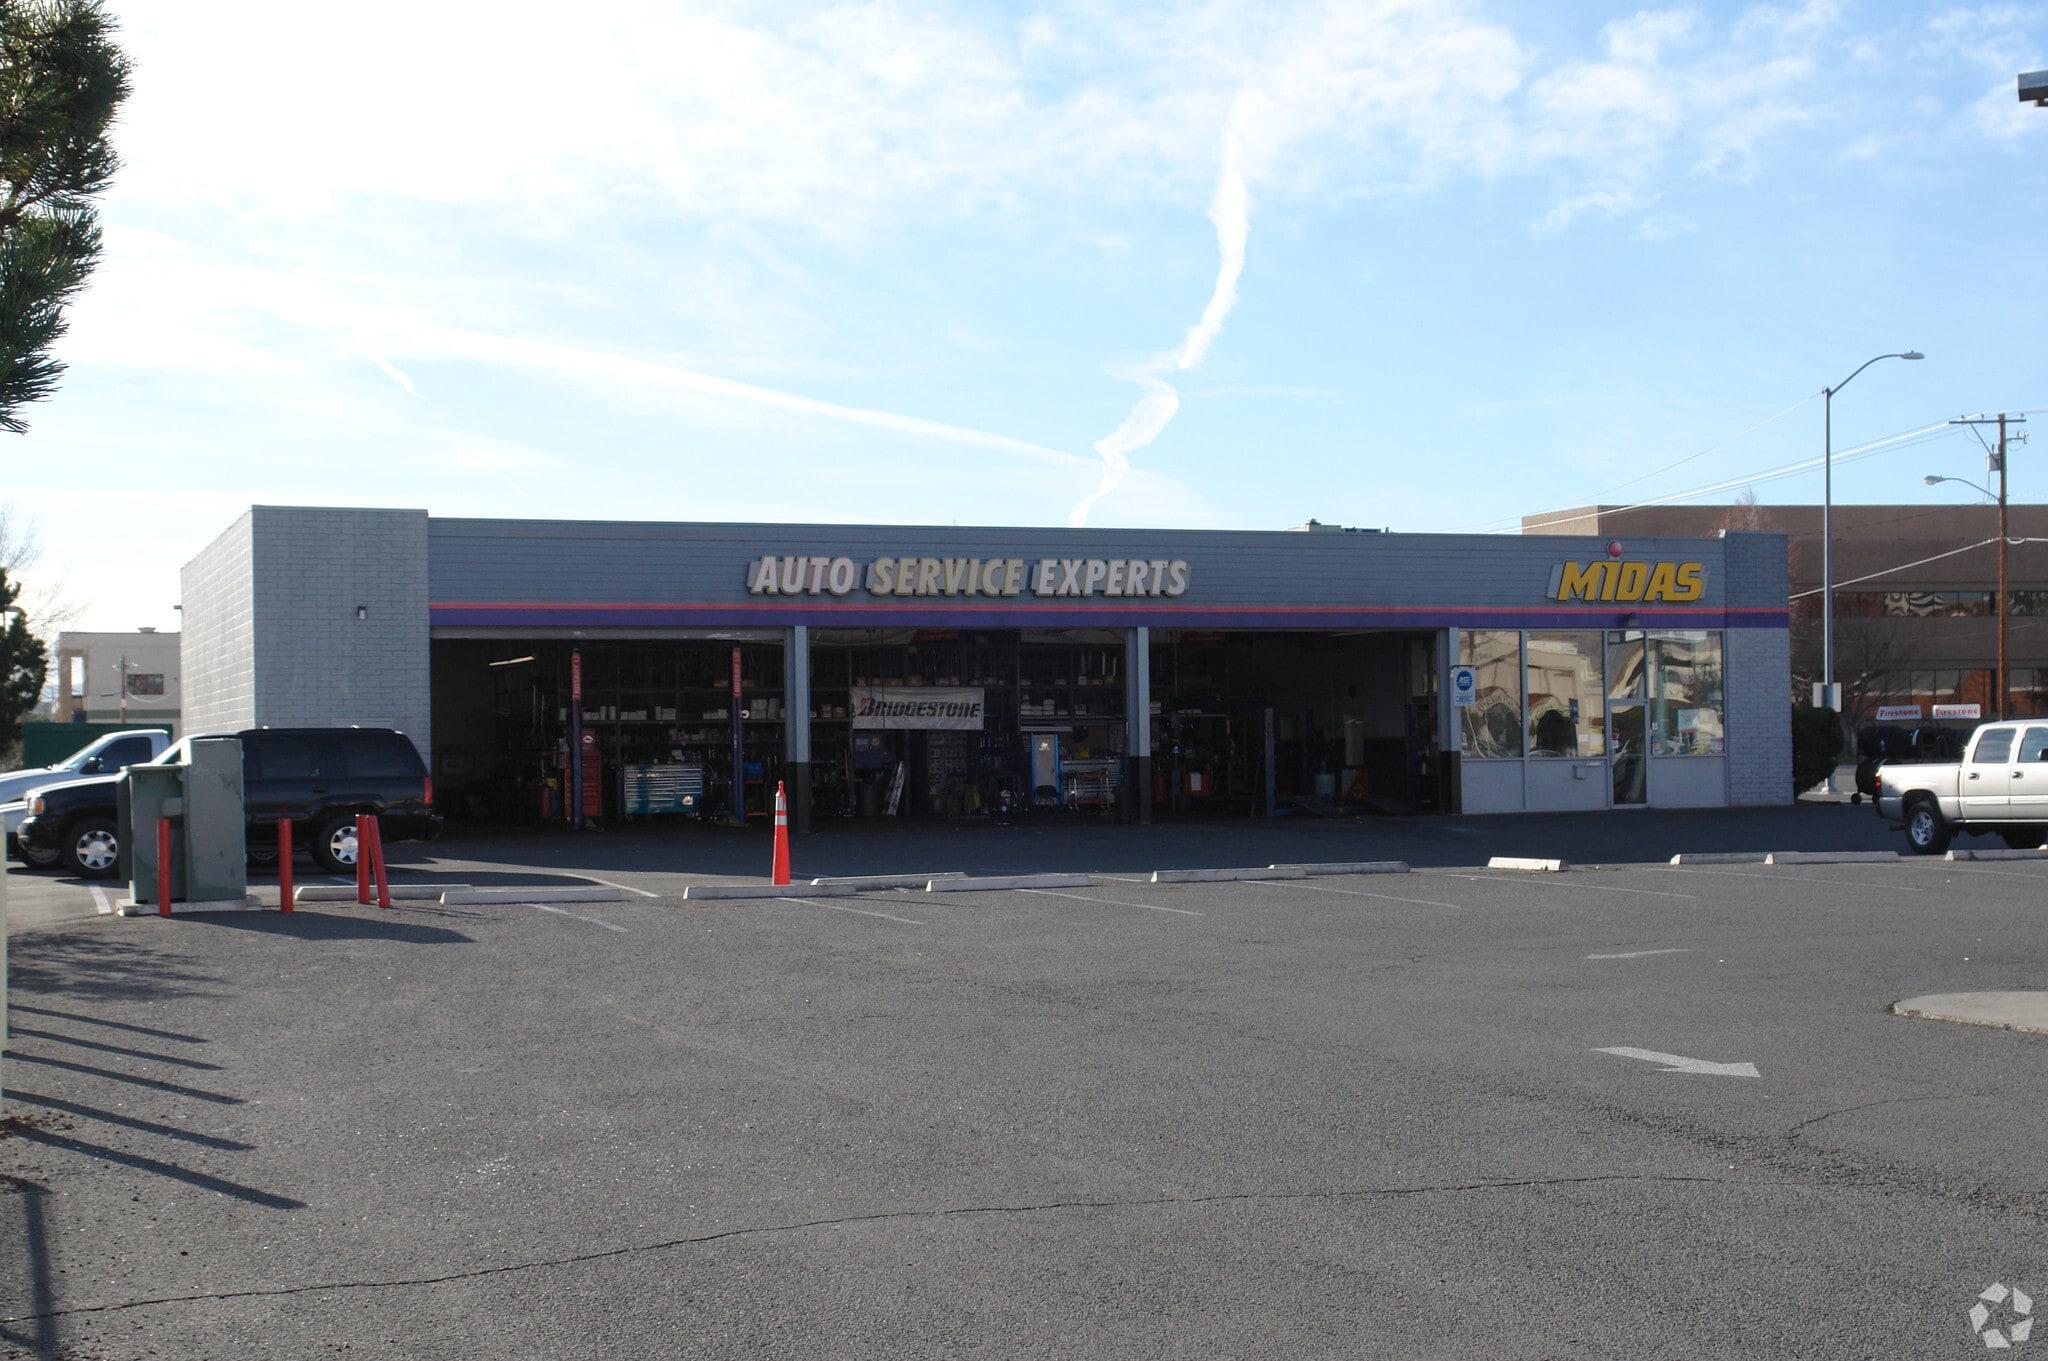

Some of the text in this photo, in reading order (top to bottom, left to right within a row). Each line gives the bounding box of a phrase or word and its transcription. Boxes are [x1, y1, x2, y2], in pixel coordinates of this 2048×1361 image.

[751, 556, 1188, 598] AUTO SERVICE EXPERTS
[1557, 541, 1704, 602] MIDAS
[857, 697, 981, 718] BRIDGESTONE
[1879, 709, 1920, 718] Firestone
[1935, 708, 1979, 718] Firestone
